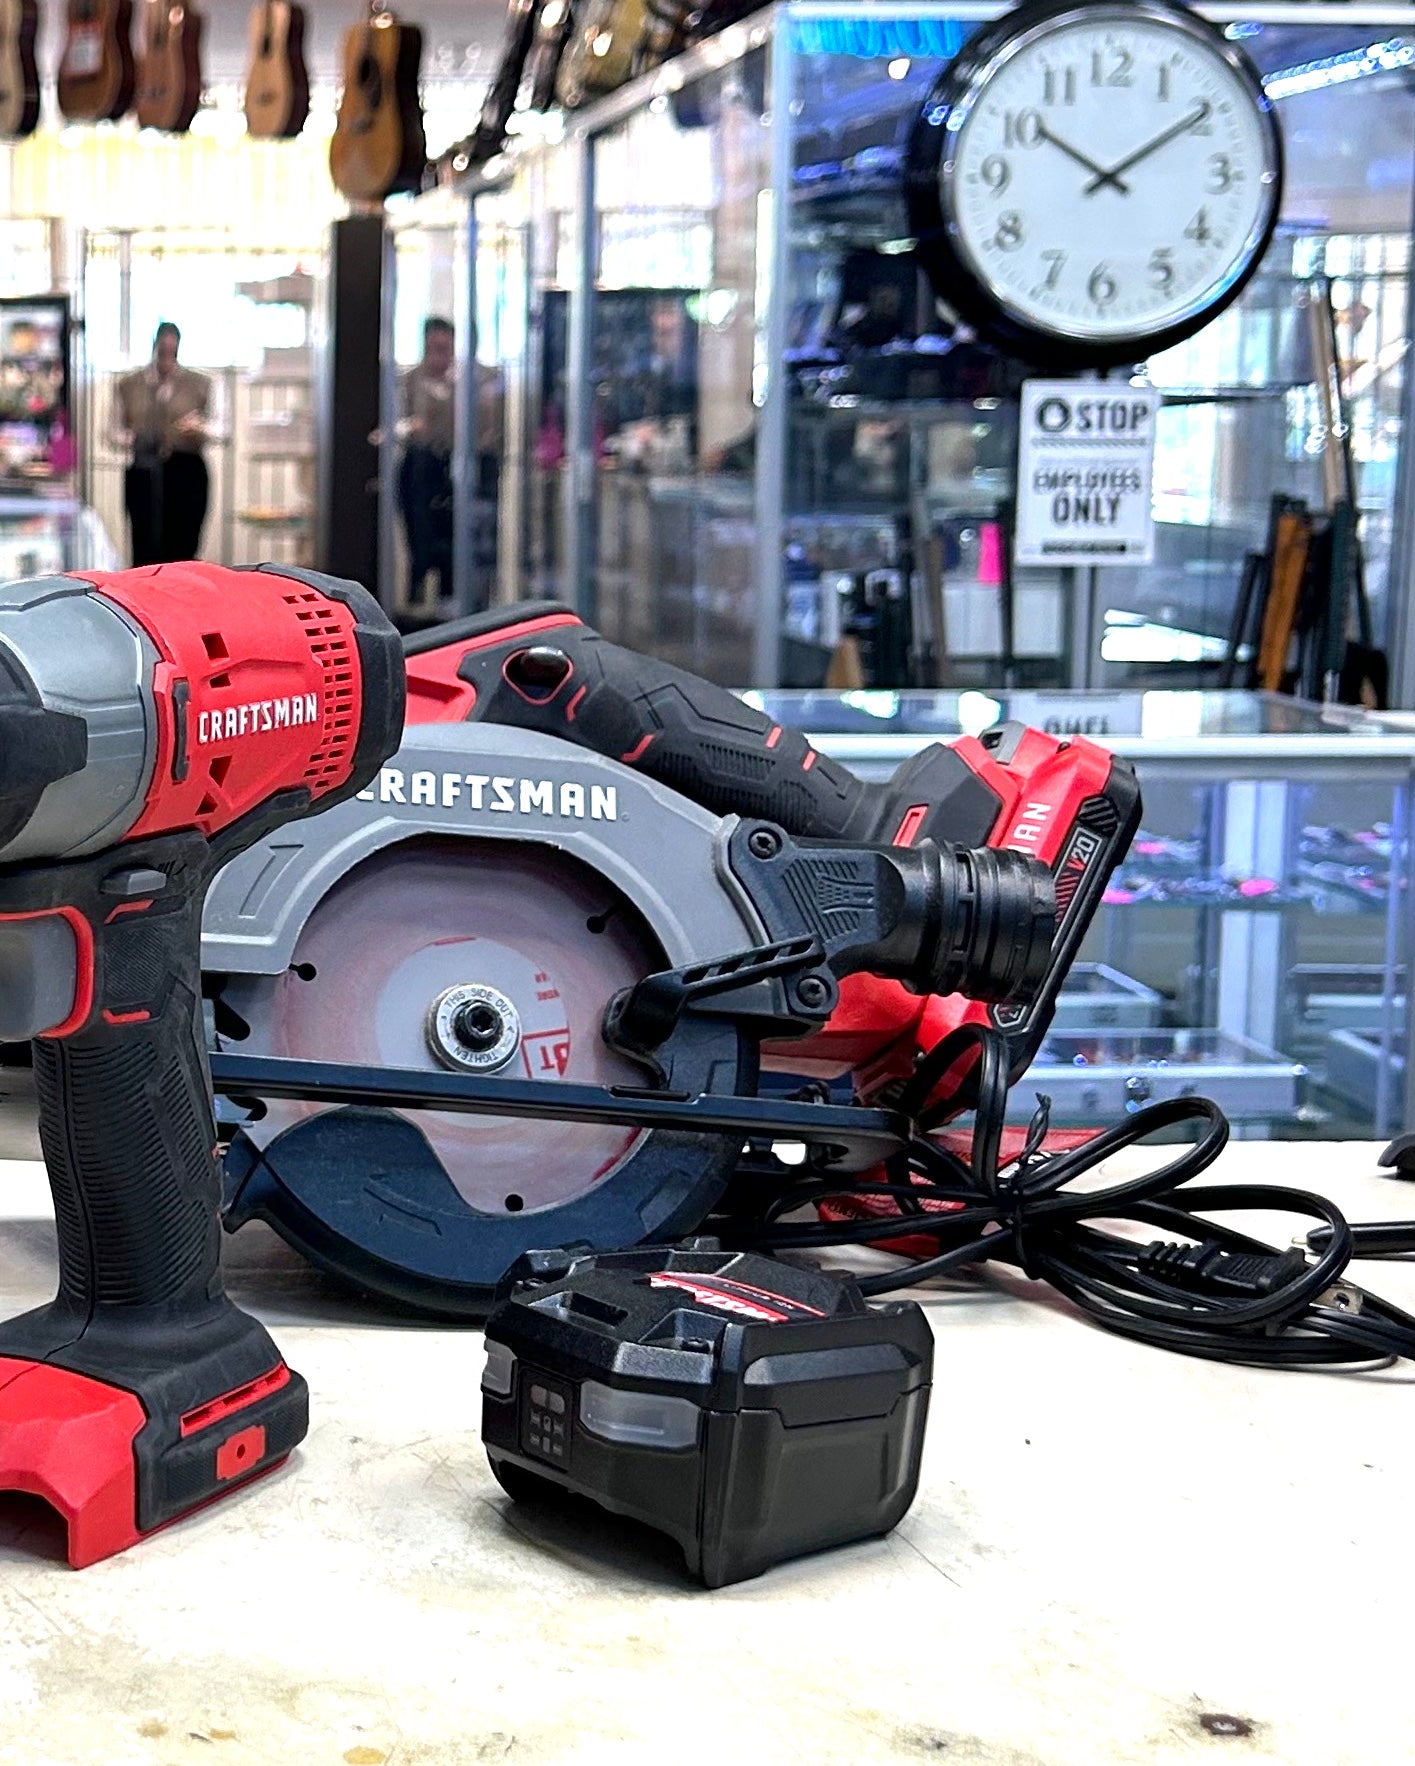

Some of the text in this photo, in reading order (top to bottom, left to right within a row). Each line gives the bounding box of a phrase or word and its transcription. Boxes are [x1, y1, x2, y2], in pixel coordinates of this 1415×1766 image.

[1042, 65, 1077, 107] 11
[1089, 48, 1133, 88] 12
[1157, 61, 1170, 103] 1
[1002, 107, 1046, 151] 10
[1185, 95, 1213, 137] 2
[981, 152, 1012, 199] 9
[1204, 151, 1234, 196] 3
[994, 209, 1025, 253] 8
[1183, 205, 1212, 247] 4
[1039, 248, 1068, 289] 7
[1087, 258, 1117, 305] 6
[1148, 246, 1176, 287] 5
[1076, 400, 1149, 431] STOP
[1052, 492, 1122, 527] ONLY
[198, 692, 318, 744] CRAFTSMAN
[1066, 835, 1096, 872] V20
[444, 987, 514, 1018] THIS SIDE OUT
[453, 1045, 500, 1064] TIGHTEN
